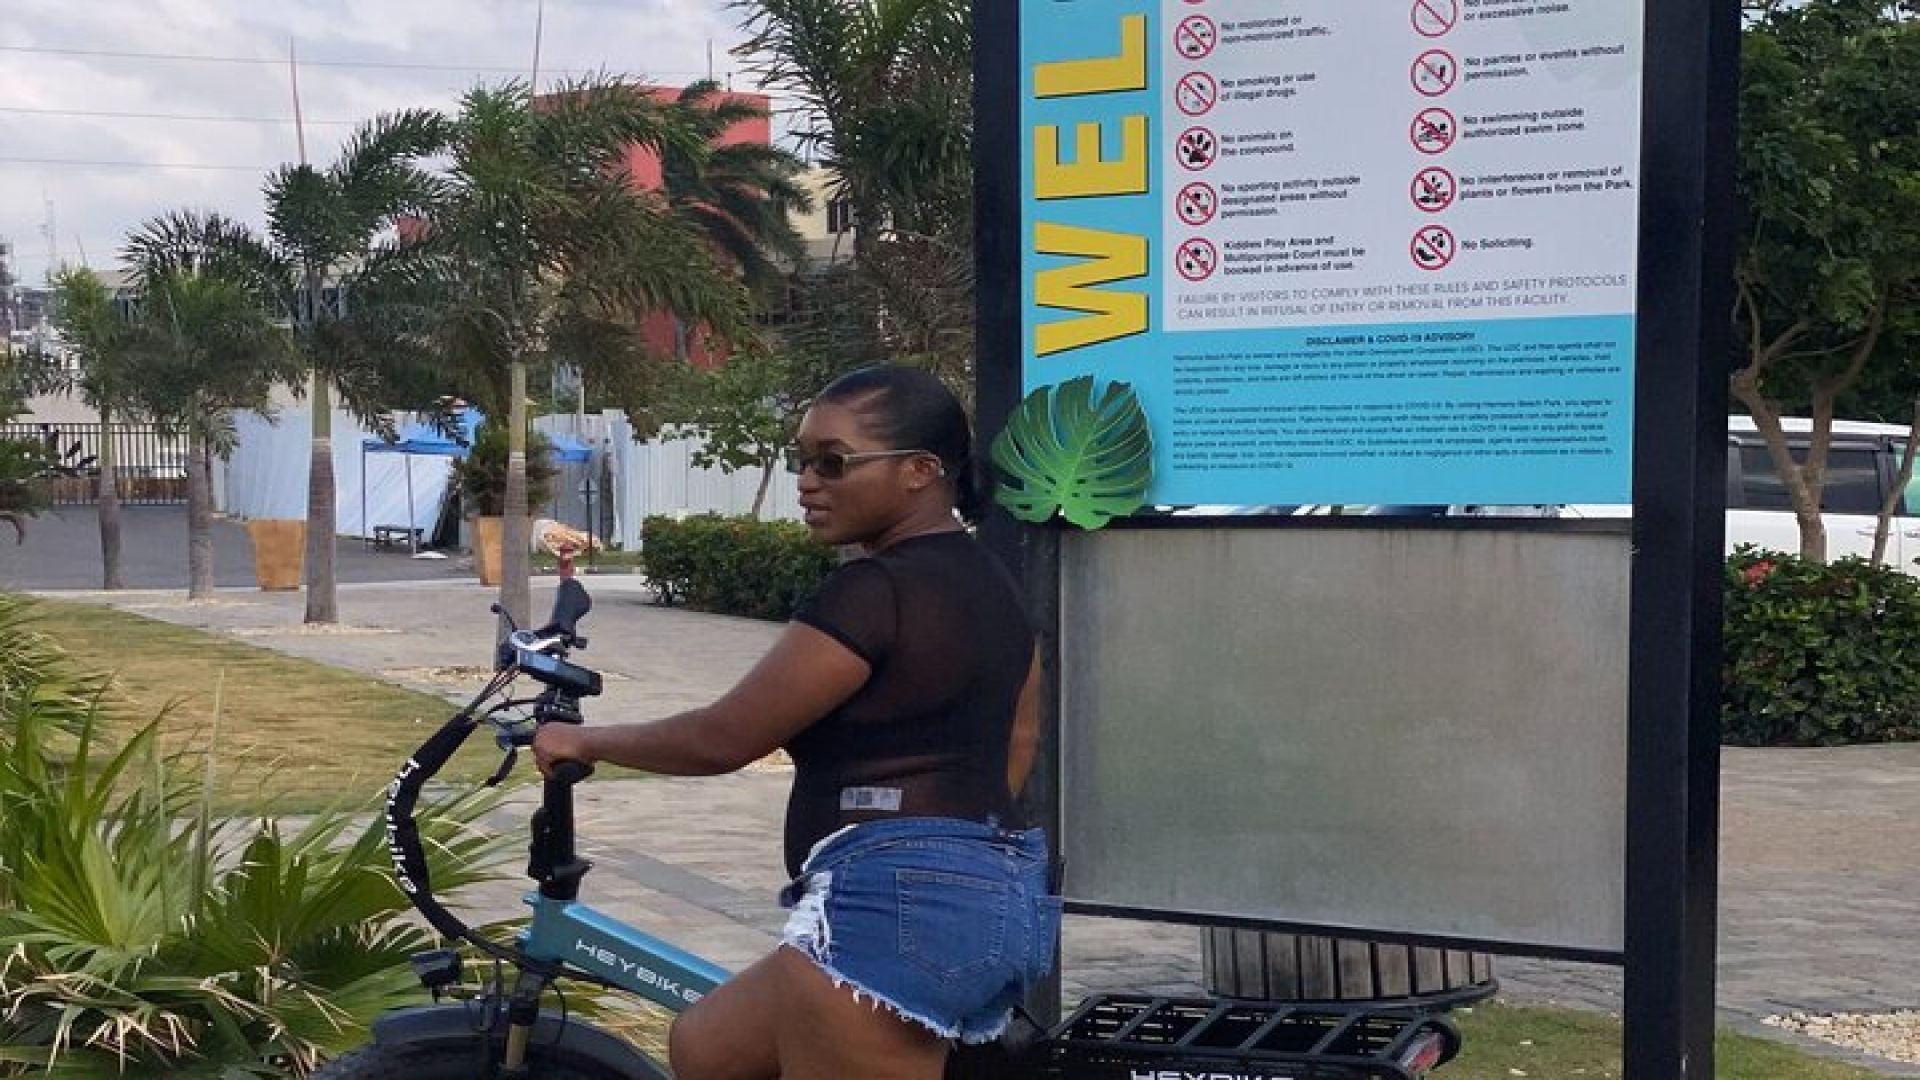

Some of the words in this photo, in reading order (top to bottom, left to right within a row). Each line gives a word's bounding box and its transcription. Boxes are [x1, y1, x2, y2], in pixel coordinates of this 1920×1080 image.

[1237, 18, 1288, 29] motorized
[1482, 54, 1520, 65] parties
[1539, 49, 1577, 60] events
[1581, 45, 1625, 56] without
[1237, 77, 1280, 86] smoking
[1481, 112, 1538, 124] swimming
[1541, 108, 1584, 119] outside
[1237, 133, 1277, 142] animals
[1463, 126, 1521, 138] authorized
[1524, 126, 1553, 134] swim
[1034, 0, 1149, 358] WEL
[1477, 173, 1544, 184] interference
[1562, 167, 1608, 178] removal
[1610, 166, 1622, 176] of
[1221, 184, 1235, 192] No
[1237, 182, 1280, 191] sporting
[1282, 180, 1318, 189] activity
[1322, 177, 1360, 186] outside
[1460, 190, 1493, 200] plants
[1511, 187, 1552, 196] flowers
[1555, 184, 1582, 193] from
[1584, 182, 1603, 191] the
[1221, 195, 1276, 205] designated
[1279, 193, 1307, 202] areas
[1309, 189, 1347, 198] without
[1264, 239, 1286, 247] Play
[1314, 236, 1334, 245] and
[1461, 241, 1478, 250] No
[1224, 252, 1289, 263] Multipurpose
[1293, 250, 1320, 259] Court
[1322, 248, 1350, 257] must
[1352, 248, 1365, 256] be
[1224, 265, 1262, 275] booked
[1276, 263, 1318, 272] advance
[1320, 261, 1331, 270] of
[1178, 294, 1218, 303] FAILURE
[1220, 293, 1235, 303] BY
[1239, 290, 1288, 301] VISITORS
[1292, 290, 1307, 299] TO
[1311, 288, 1359, 299] COMPLY
[1362, 286, 1393, 295] WITH
[1396, 284, 1430, 295] THESE
[1433, 282, 1469, 293] RULES
[1471, 281, 1499, 290] AND
[1503, 279, 1545, 290] SAFETY
[1548, 275, 1627, 288] PROTOCOLS
[1179, 309, 1203, 319] CAN
[1205, 306, 1244, 318] RESULT
[1261, 306, 1307, 315] REFUSAL
[1310, 304, 1326, 313] OF
[1330, 303, 1364, 313] ENTRY
[1367, 302, 1385, 312] OR
[1388, 299, 1444, 310] REMOVAL
[1447, 297, 1483, 307] FROM
[1485, 297, 1512, 306] THIS
[576, 939, 704, 1003] HEYBIKE
